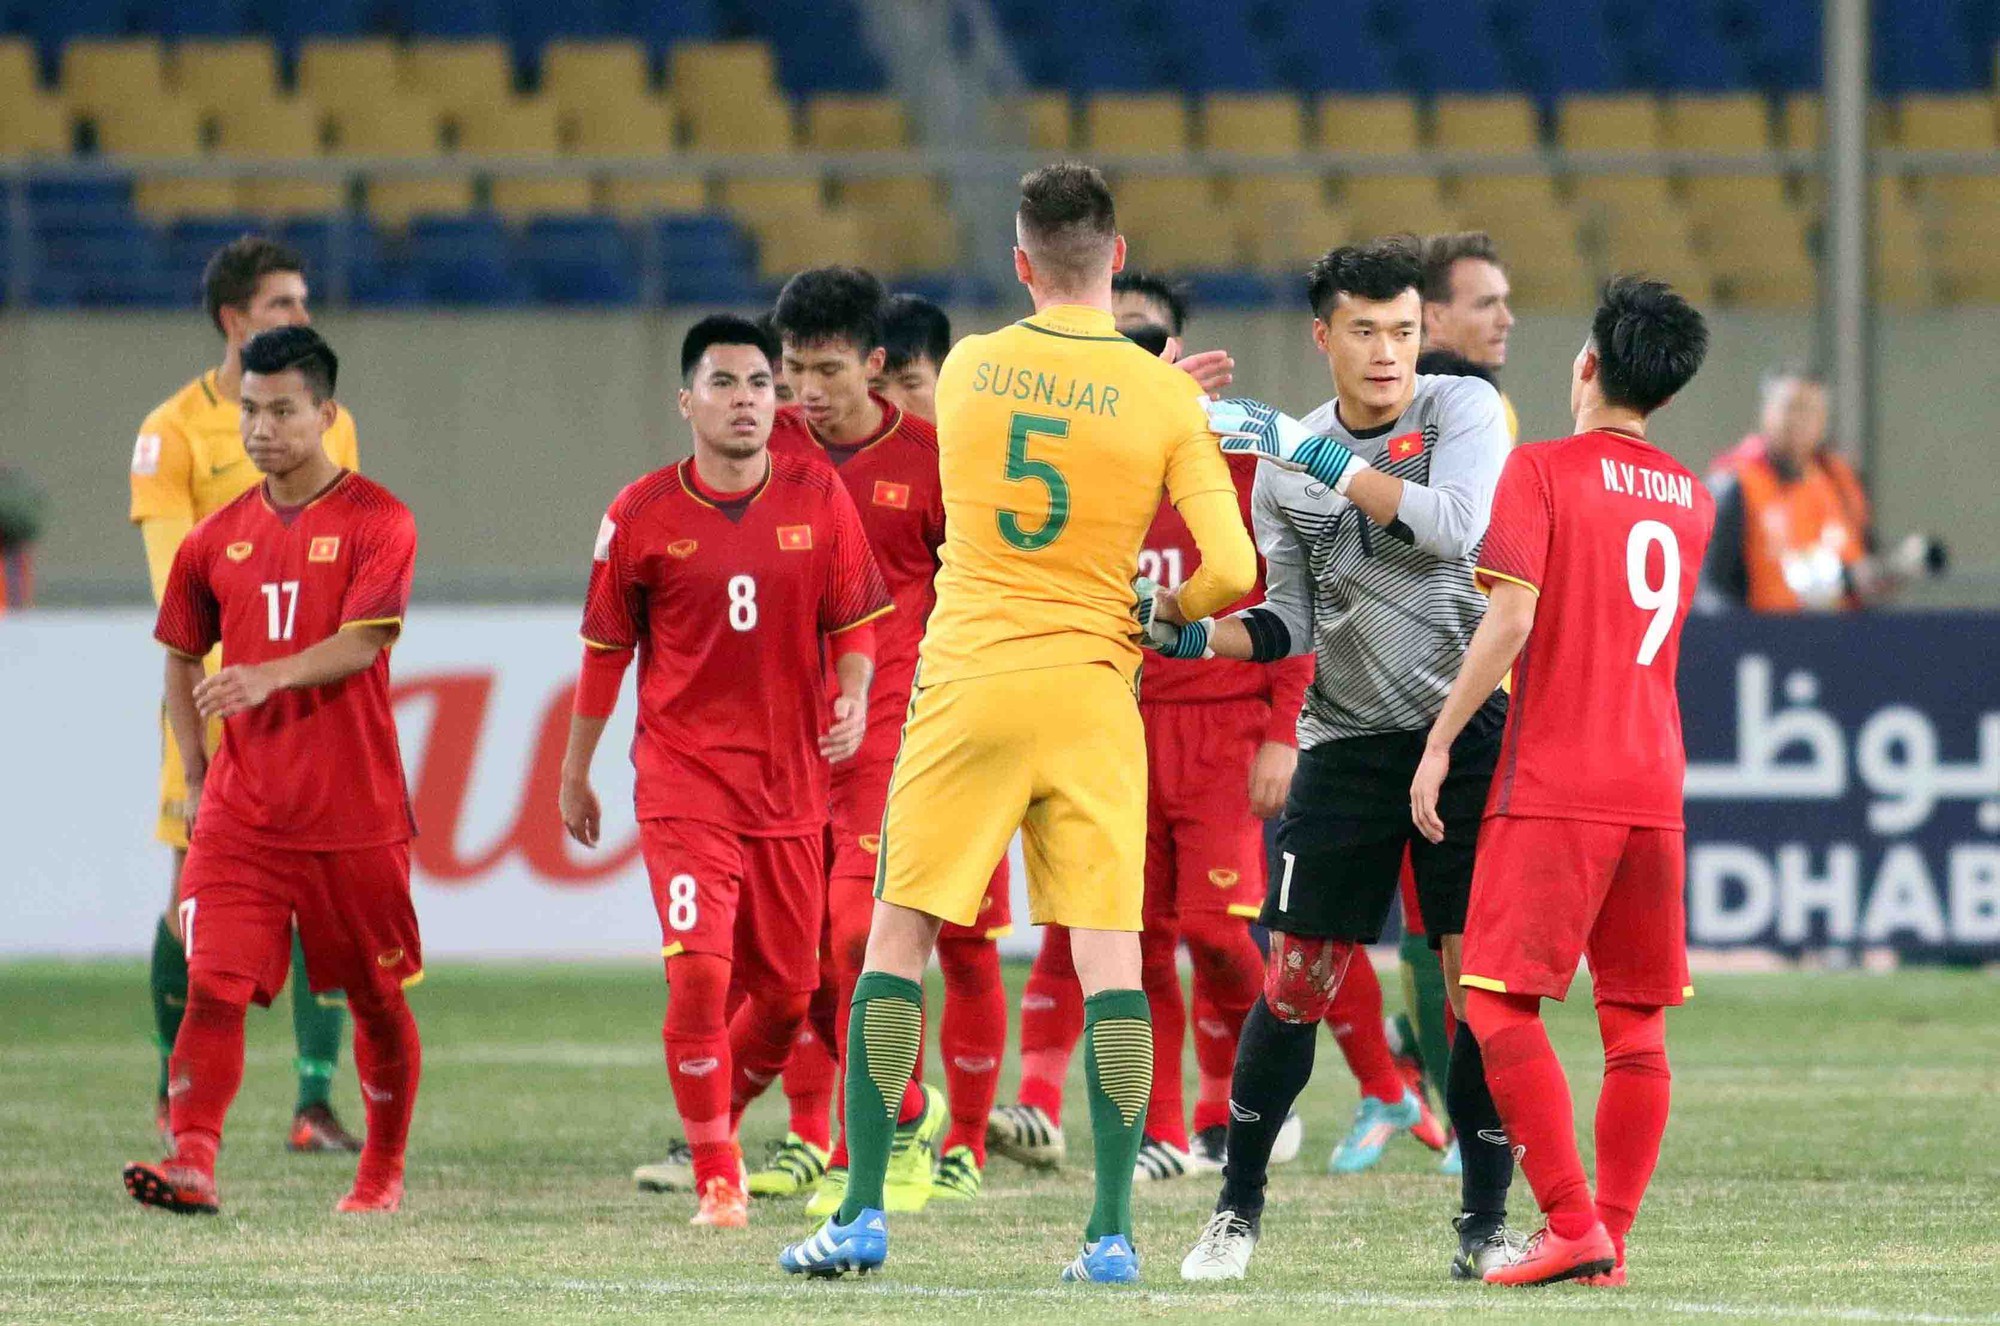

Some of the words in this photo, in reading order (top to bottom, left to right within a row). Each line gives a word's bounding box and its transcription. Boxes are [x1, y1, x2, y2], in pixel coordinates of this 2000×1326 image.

[973, 362, 1119, 417] SUSNJAR
[996, 411, 1070, 552] 5
[1601, 458, 1693, 508] N.V.TOAN
[1138, 548, 1181, 590] 21
[1626, 519, 1681, 666] 9
[261, 580, 299, 640] 17
[728, 574, 758, 631] 8
[668, 873, 698, 932] 8
[1279, 851, 1296, 913] 1
[1689, 843, 2000, 944] DHAB
